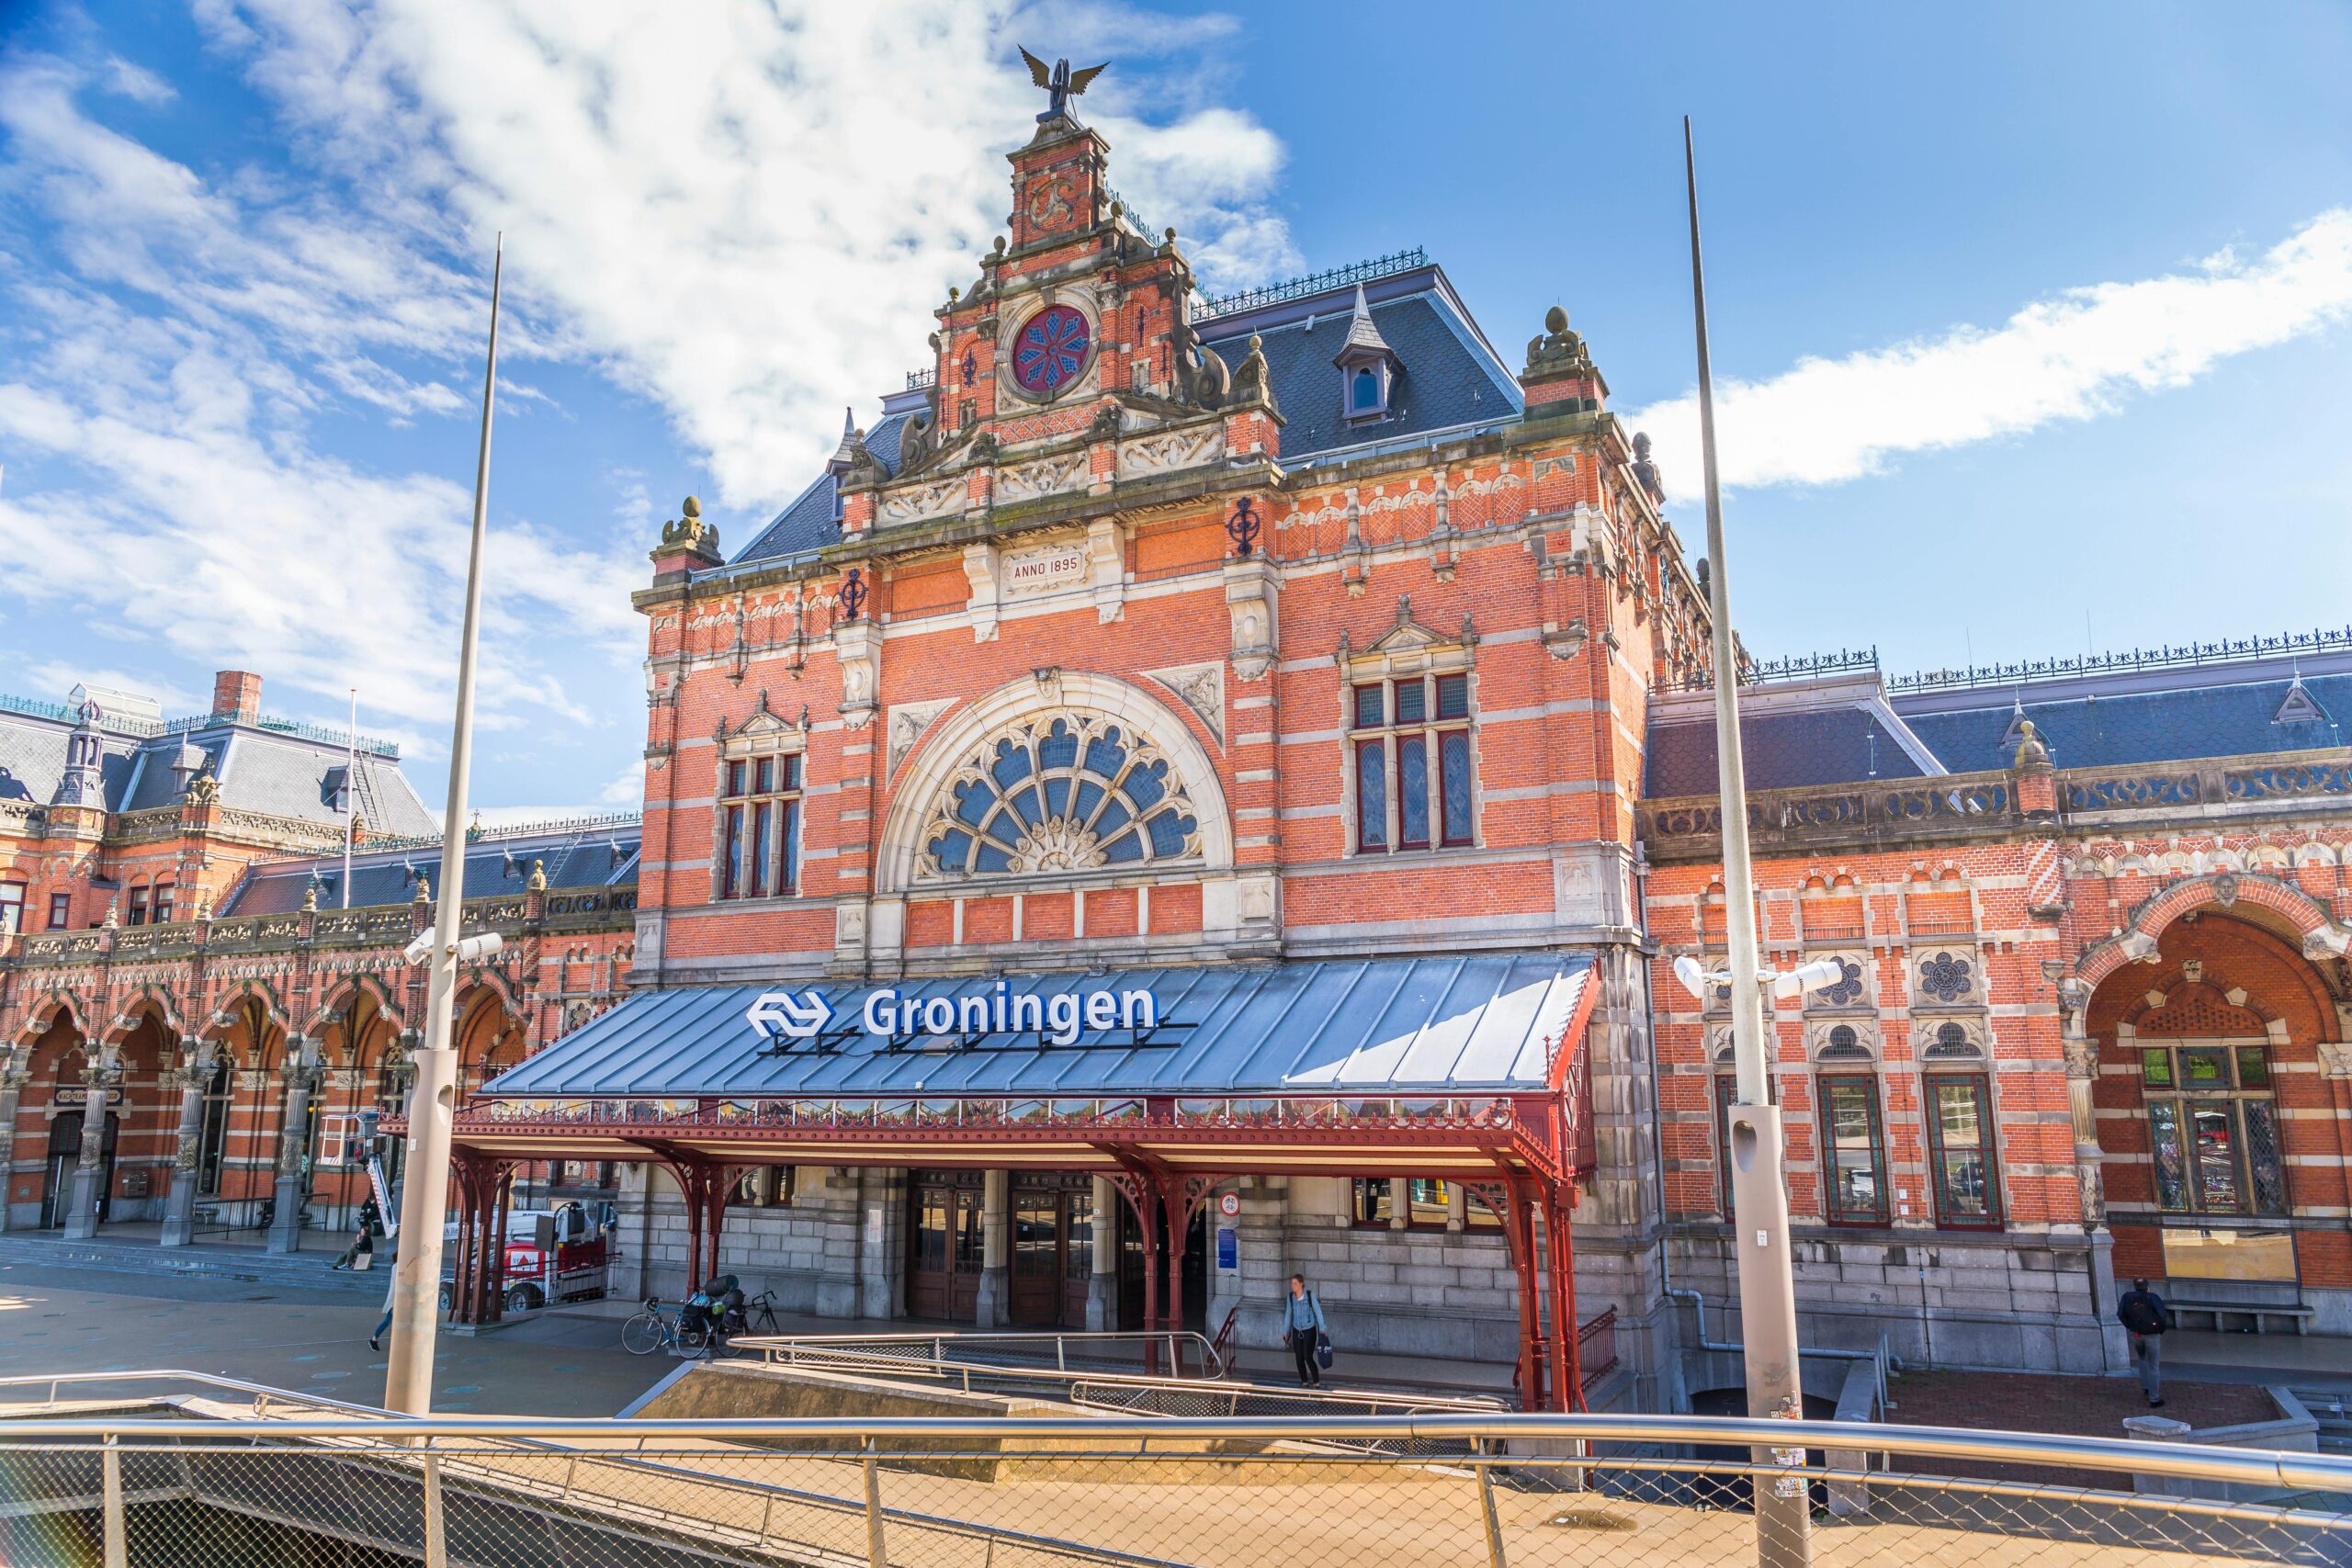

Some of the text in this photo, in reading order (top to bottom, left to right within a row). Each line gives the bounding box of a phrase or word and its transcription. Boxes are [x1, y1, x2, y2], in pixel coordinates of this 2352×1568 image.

[1014, 558, 1077, 579] ANNO 1895
[864, 981, 1158, 1045] Groningen
